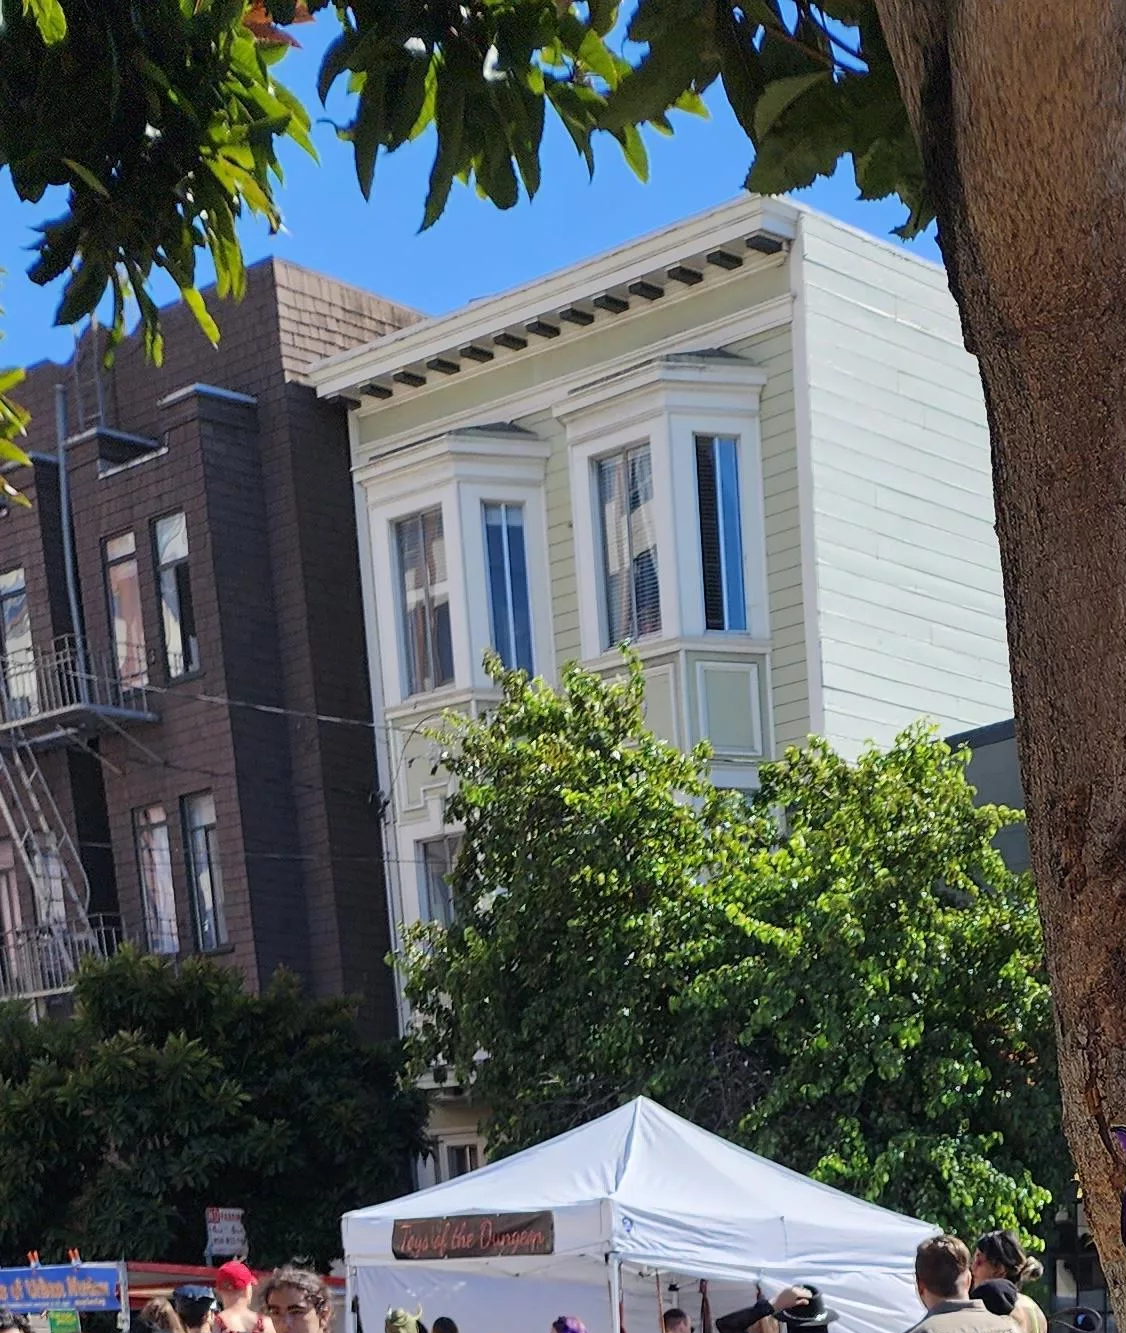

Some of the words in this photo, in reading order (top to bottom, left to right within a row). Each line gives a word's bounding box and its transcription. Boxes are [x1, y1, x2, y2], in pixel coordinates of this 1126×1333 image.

[400, 1224, 429, 1259] Toys
[431, 1221, 450, 1257] of
[450, 1220, 474, 1249] the
[479, 1218, 545, 1255] Dungeon
